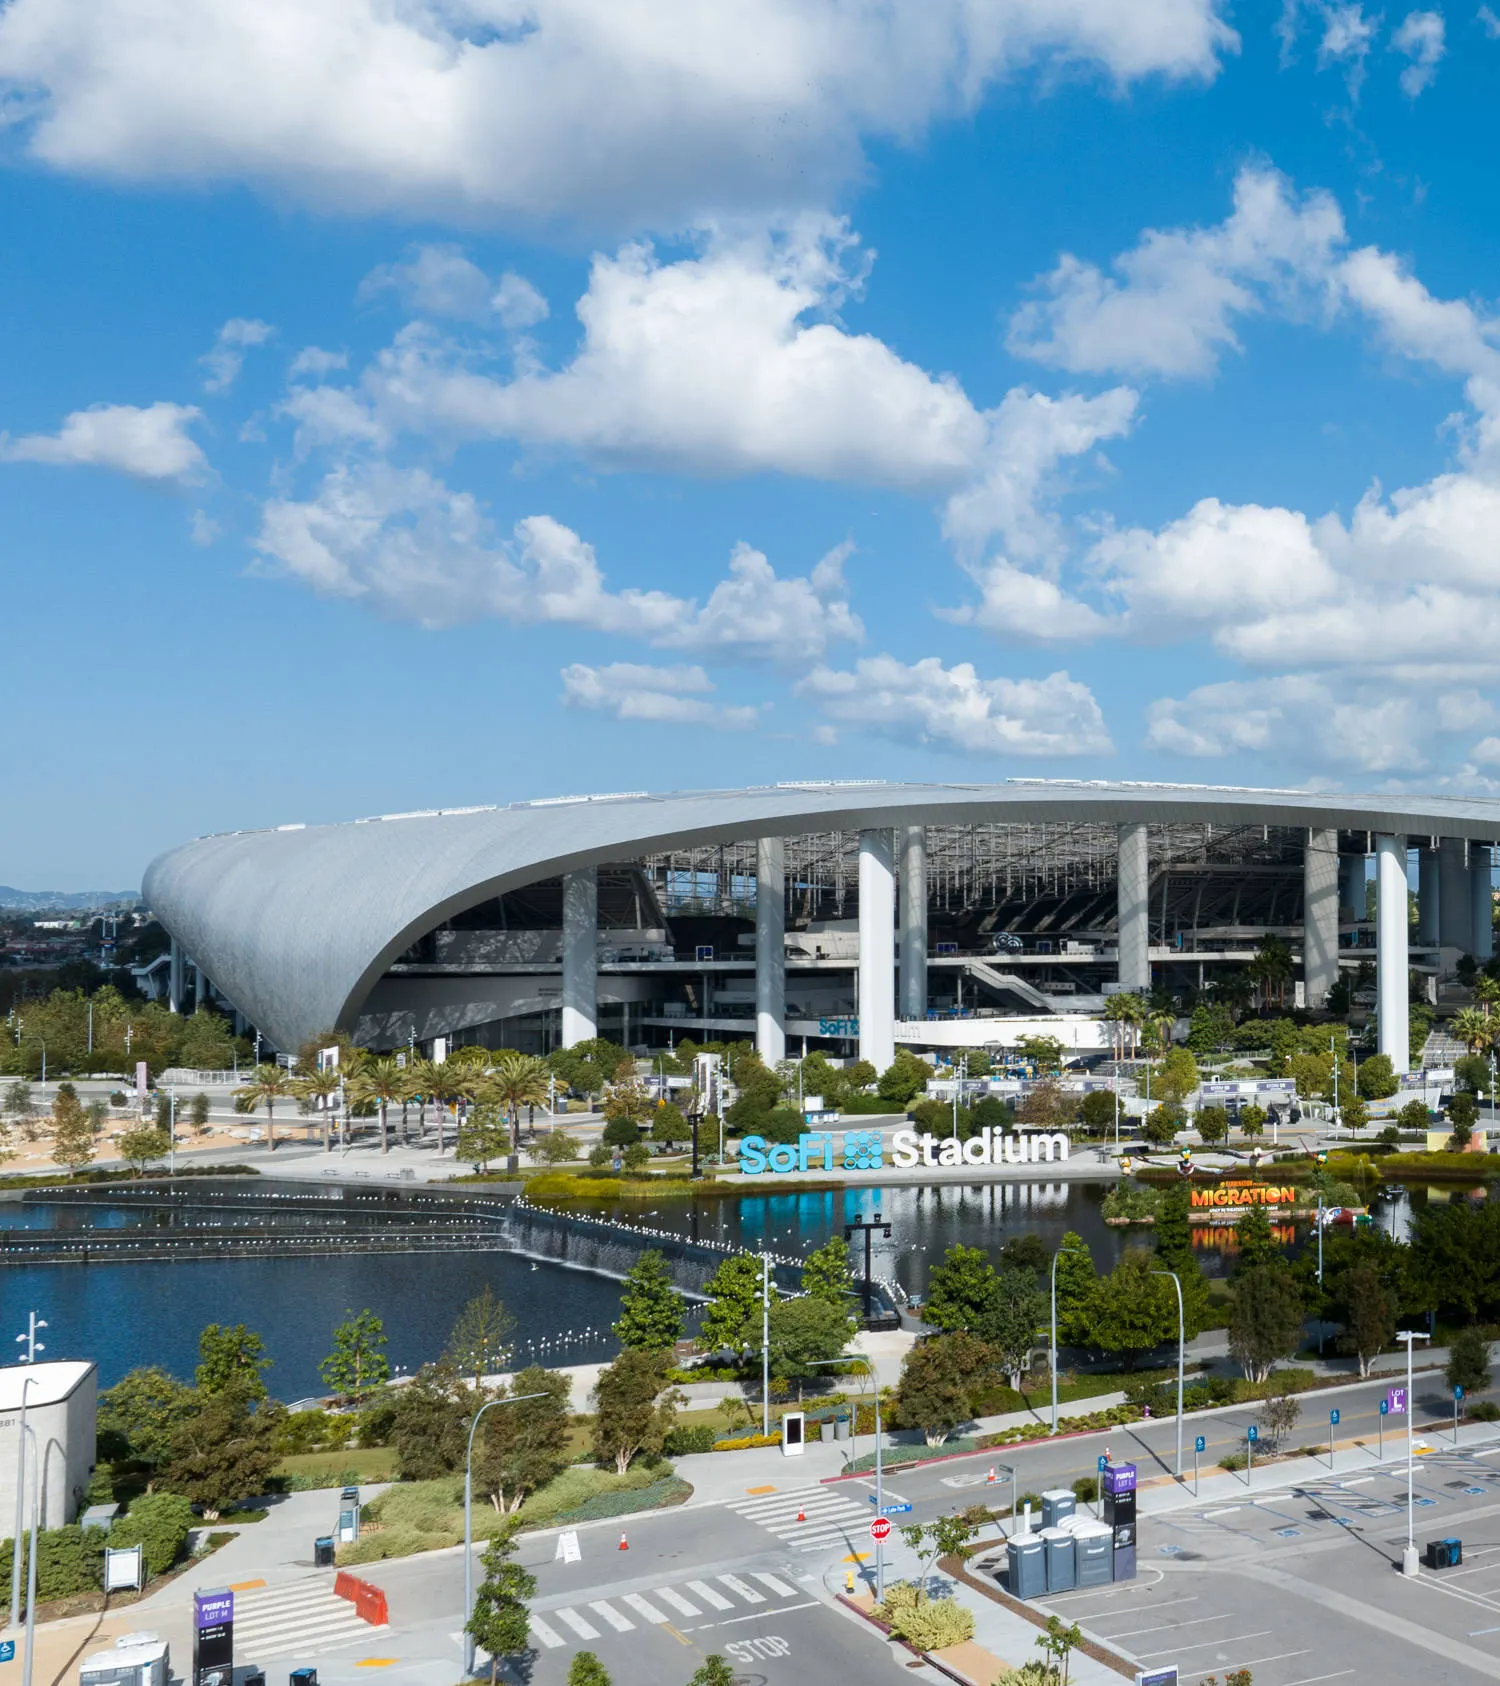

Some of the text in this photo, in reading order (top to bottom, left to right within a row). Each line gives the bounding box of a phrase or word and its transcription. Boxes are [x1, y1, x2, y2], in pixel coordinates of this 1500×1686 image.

[819, 1017, 848, 1035] SoFi
[739, 1126, 1069, 1174] SoFi Stadium
[1191, 1186, 1295, 1206] MIGRATION
[1391, 1389, 1404, 1397] LOT
[1393, 1396, 1402, 1408] L
[1115, 1471, 1135, 1480] PURPLE
[872, 1523, 889, 1534] STOP
[202, 1600, 231, 1612] PURPLE
[205, 1611, 219, 1620] LOT
[724, 1635, 791, 1663] STOP
